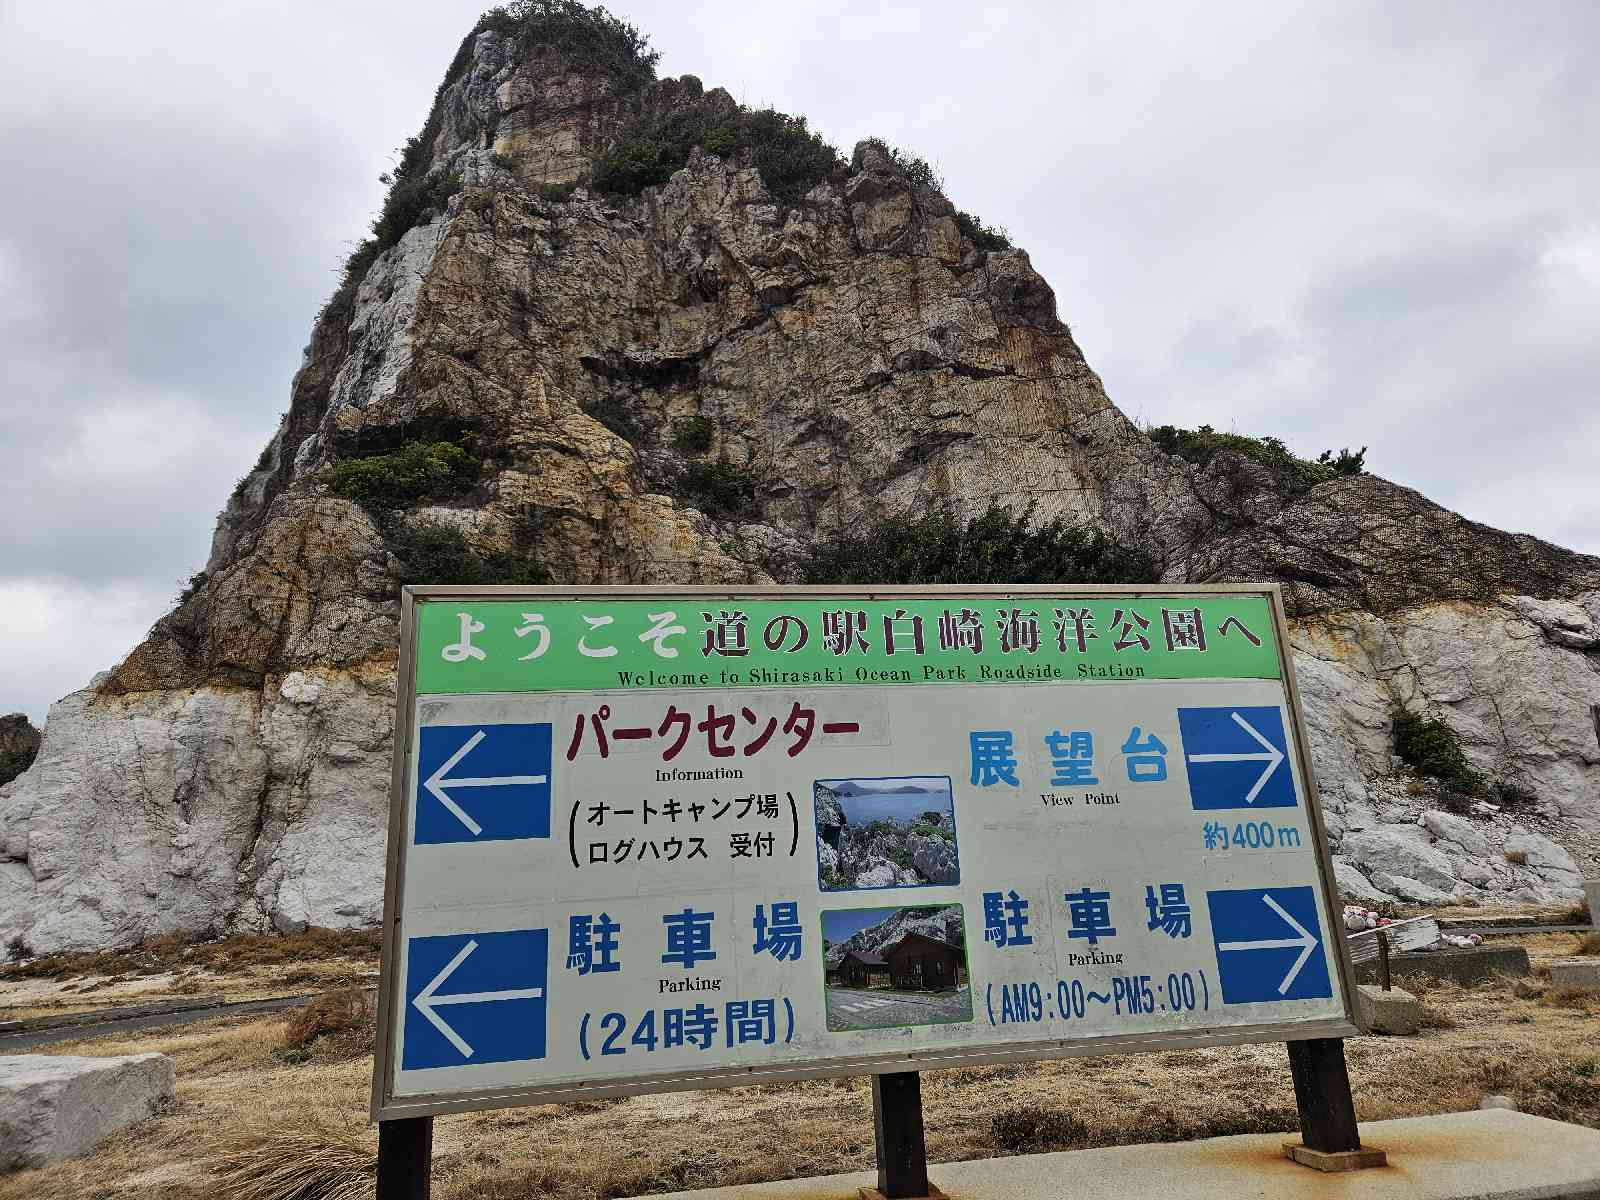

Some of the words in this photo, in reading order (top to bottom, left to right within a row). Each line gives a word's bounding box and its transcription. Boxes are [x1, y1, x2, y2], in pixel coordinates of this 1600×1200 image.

[618, 670, 709, 686] Welcome
[720, 670, 739, 684] to
[749, 667, 844, 684] Shirasaki
[855, 666, 912, 681] Ocean
[923, 665, 967, 680] Park
[980, 664, 1062, 679] Roadside
[1077, 663, 1146, 678] Station
[566, 702, 860, 762] パークセンター
[968, 726, 1168, 788] 展望台
[655, 767, 744, 782] Information
[1040, 793, 1074, 807] View
[1084, 791, 1121, 806] Point
[1202, 821, 1302, 851] 約400m
[983, 883, 1193, 949] 駐車場
[565, 901, 804, 977] 駐車場
[1068, 951, 1124, 967] Parking
[658, 976, 723, 994] Parking
[579, 997, 796, 1061] (24時間)
